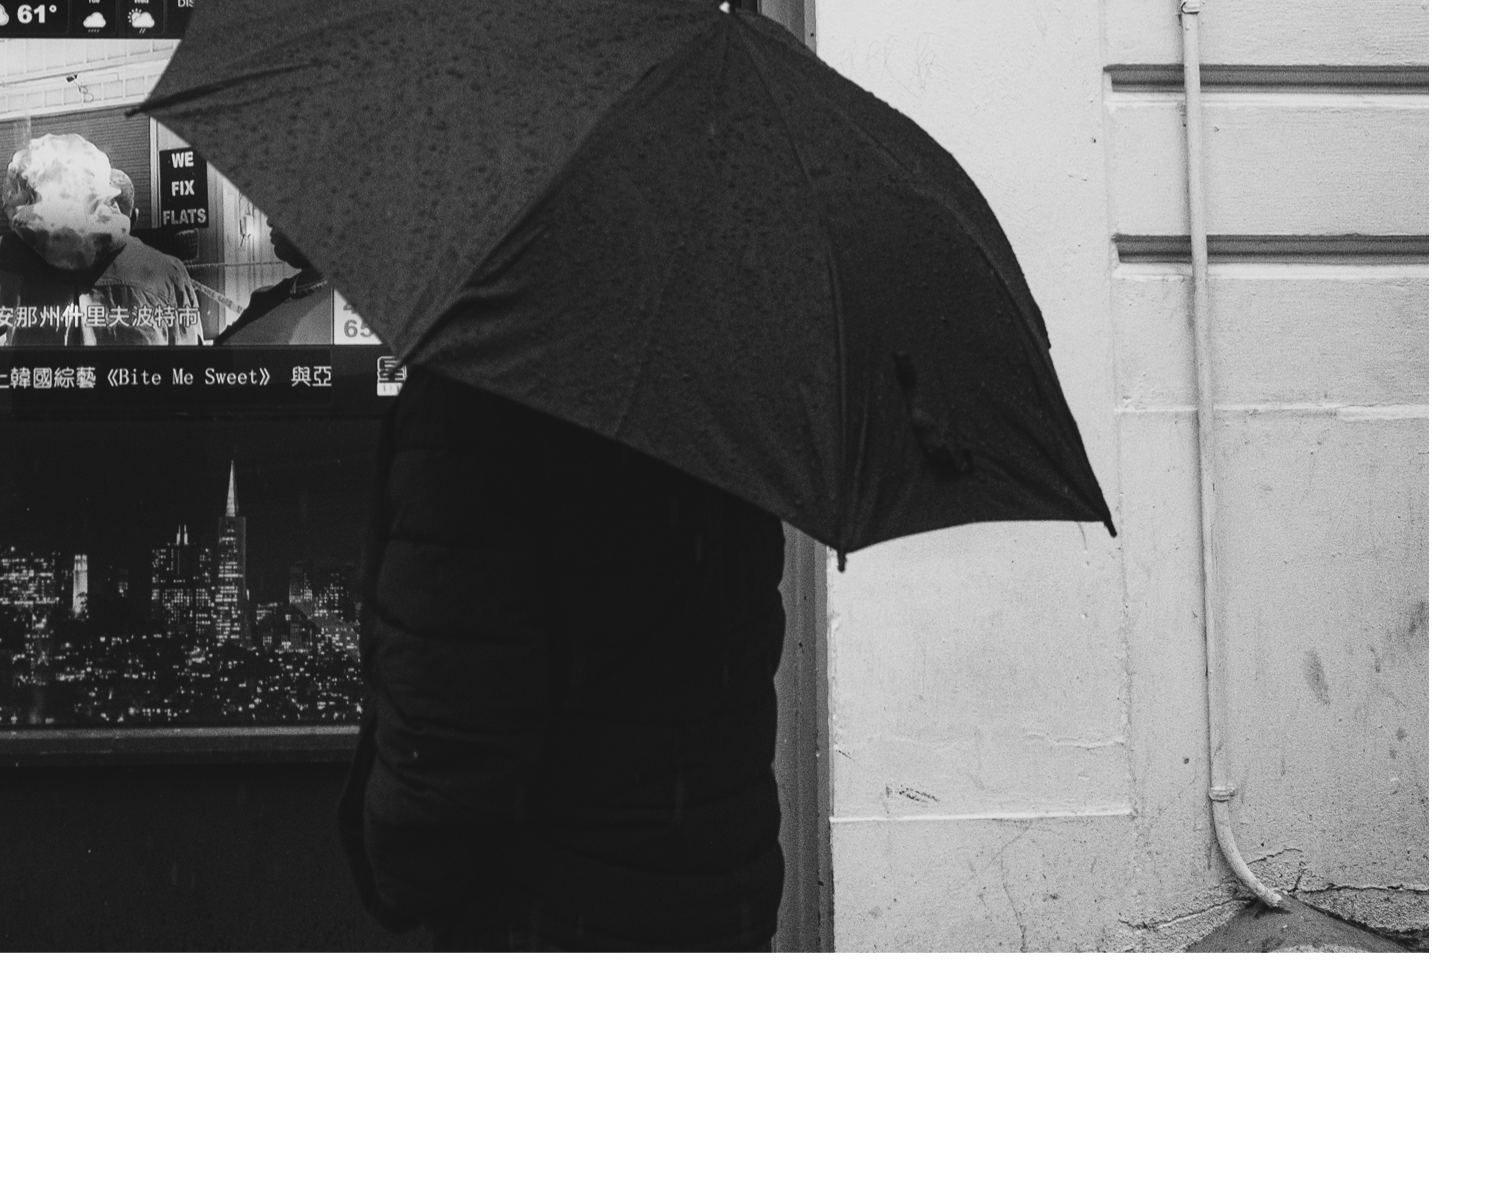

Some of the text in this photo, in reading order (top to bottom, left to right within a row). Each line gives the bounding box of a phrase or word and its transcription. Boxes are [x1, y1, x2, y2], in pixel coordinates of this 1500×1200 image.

[16, 3, 58, 24] 61°
[171, 151, 194, 168] WE
[171, 180, 195, 196] FIX
[162, 208, 207, 225] FLATS
[172, 368, 195, 386] Me
